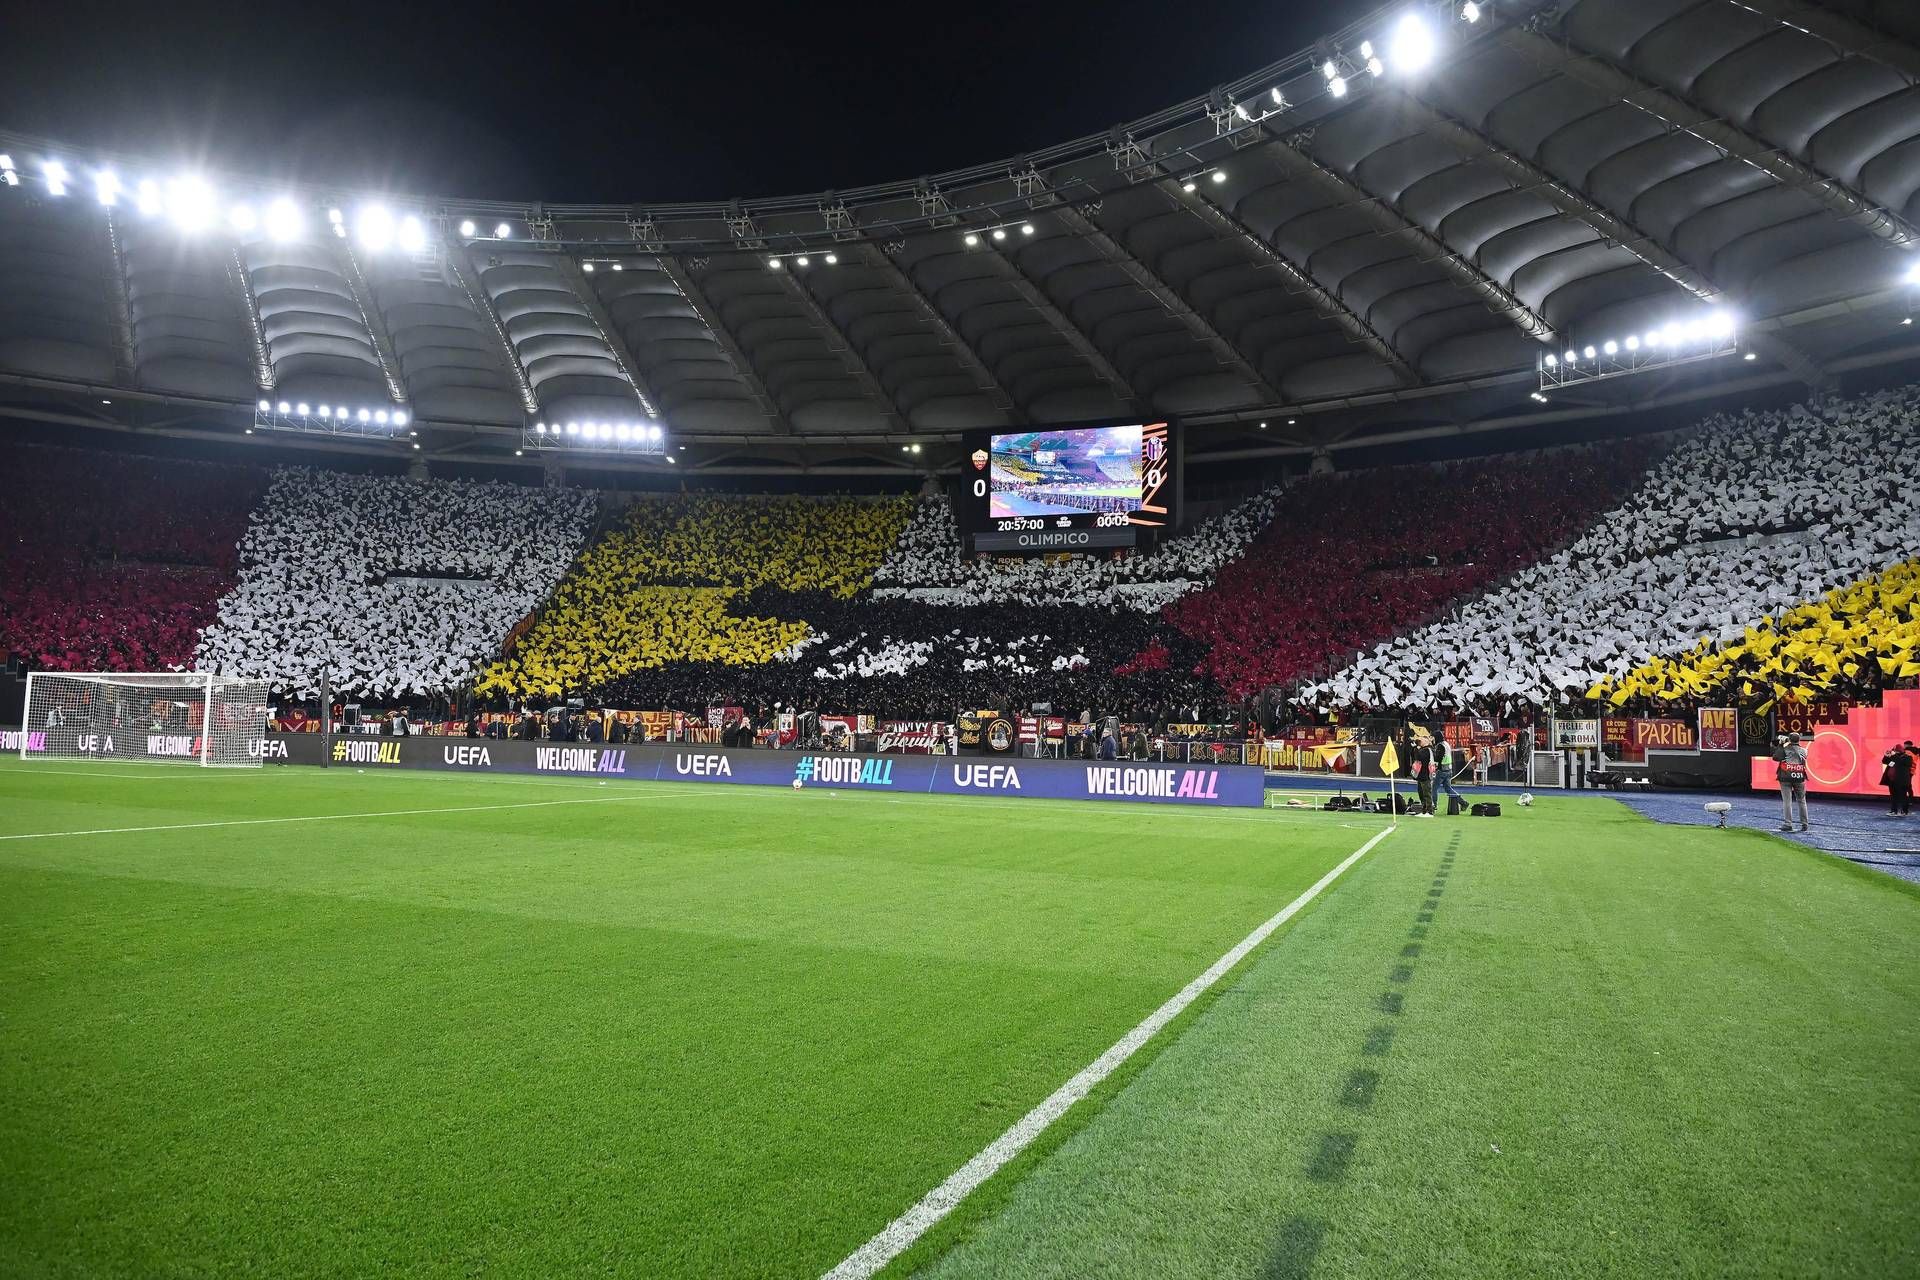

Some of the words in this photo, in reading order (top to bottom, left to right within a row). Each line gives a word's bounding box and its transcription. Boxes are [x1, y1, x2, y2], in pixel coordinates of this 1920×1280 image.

[1147, 469, 1161, 487] 0
[973, 479, 986, 497] 0
[997, 519, 1044, 531] 20:57:00
[1018, 532, 1089, 546] OLIMPICO
[1558, 720, 1584, 731] FIGLIE
[1585, 720, 1594, 731] di
[1702, 710, 1735, 729] AVE
[0, 732, 48, 751] FOOTALL
[147, 735, 192, 756] WELCOME
[1571, 733, 1596, 743] ROMA
[248, 739, 289, 758] UEFA
[333, 740, 401, 764] #FOOTBALL
[444, 745, 492, 767] UEFA
[536, 747, 597, 772] WELCOME
[597, 749, 626, 773] ALL
[676, 753, 732, 777] UEFA
[794, 756, 893, 785] #FOOTBALL
[954, 763, 1022, 789] UEFA
[1086, 767, 1176, 797] WELCOME
[1176, 769, 1219, 799] ALL
